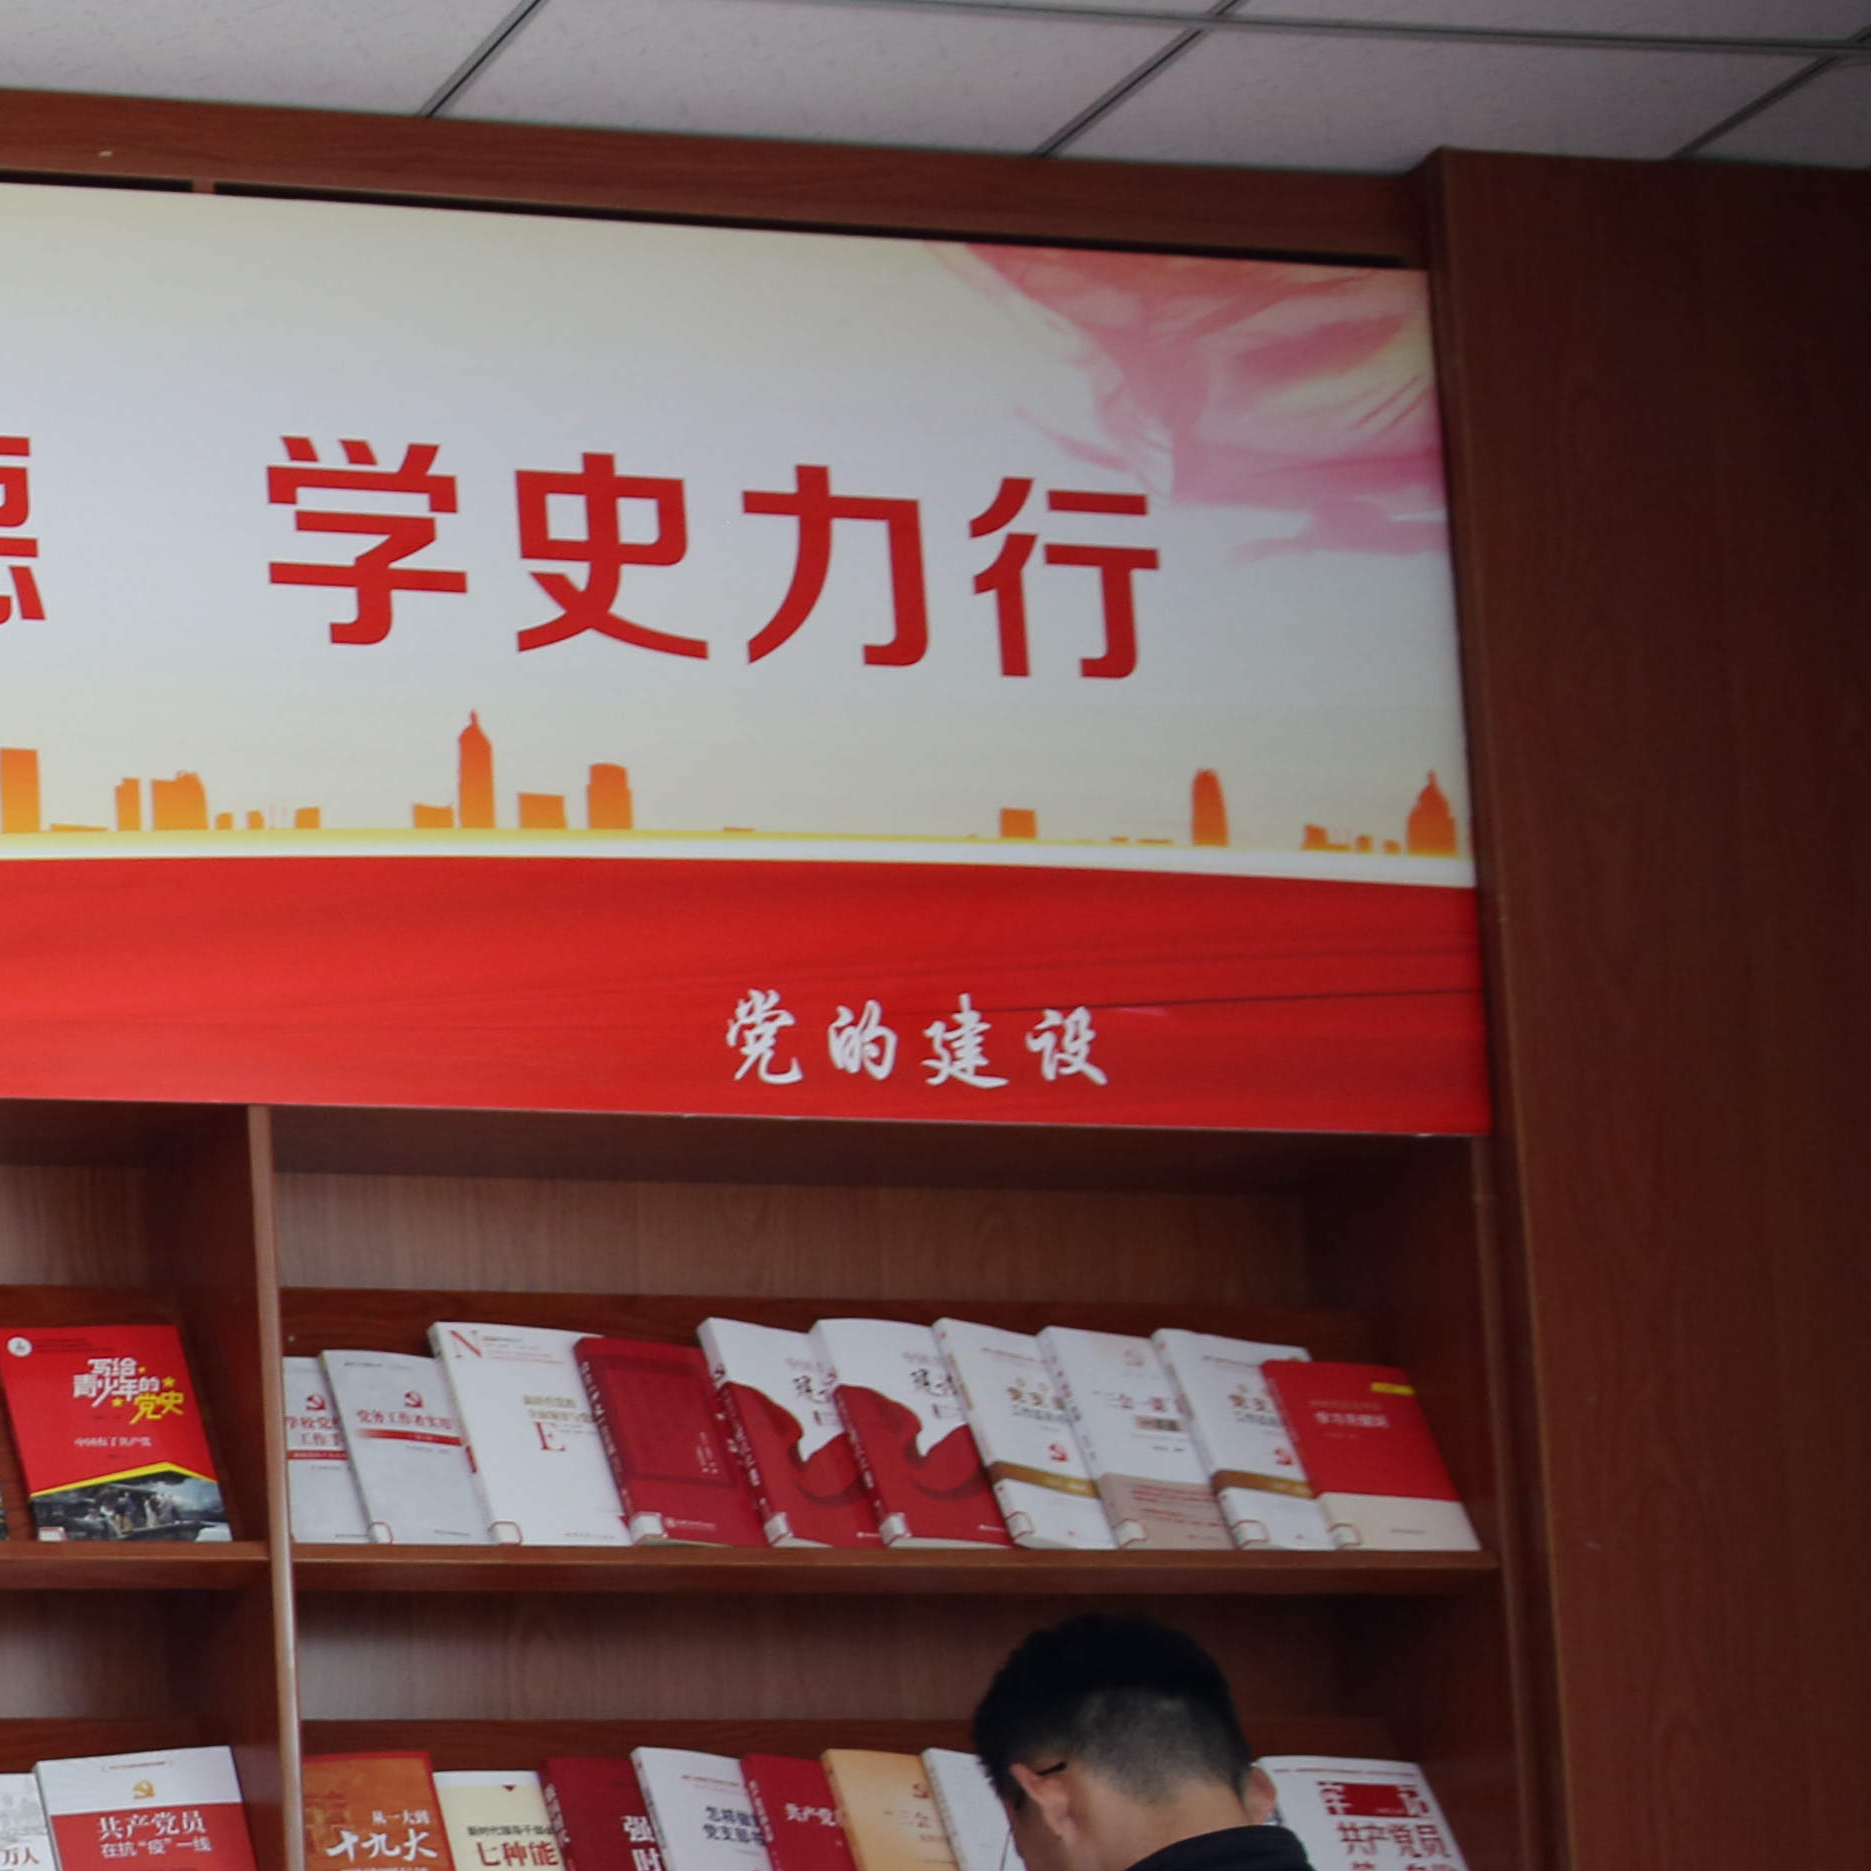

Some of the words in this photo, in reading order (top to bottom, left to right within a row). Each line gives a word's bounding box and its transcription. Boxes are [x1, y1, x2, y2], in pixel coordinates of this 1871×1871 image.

[264, 435, 1161, 681] 学史力行
[725, 988, 1109, 1089] 党的建设
[86, 1356, 138, 1377] 写给
[72, 1372, 160, 1408] 青少年的
[128, 1390, 185, 1425] 党史
[98, 1810, 207, 1841] 共产党员
[371, 1808, 432, 1825] 从一大到
[327, 1828, 438, 1863] 十九大
[1336, 1821, 1451, 1858] 共产党员
